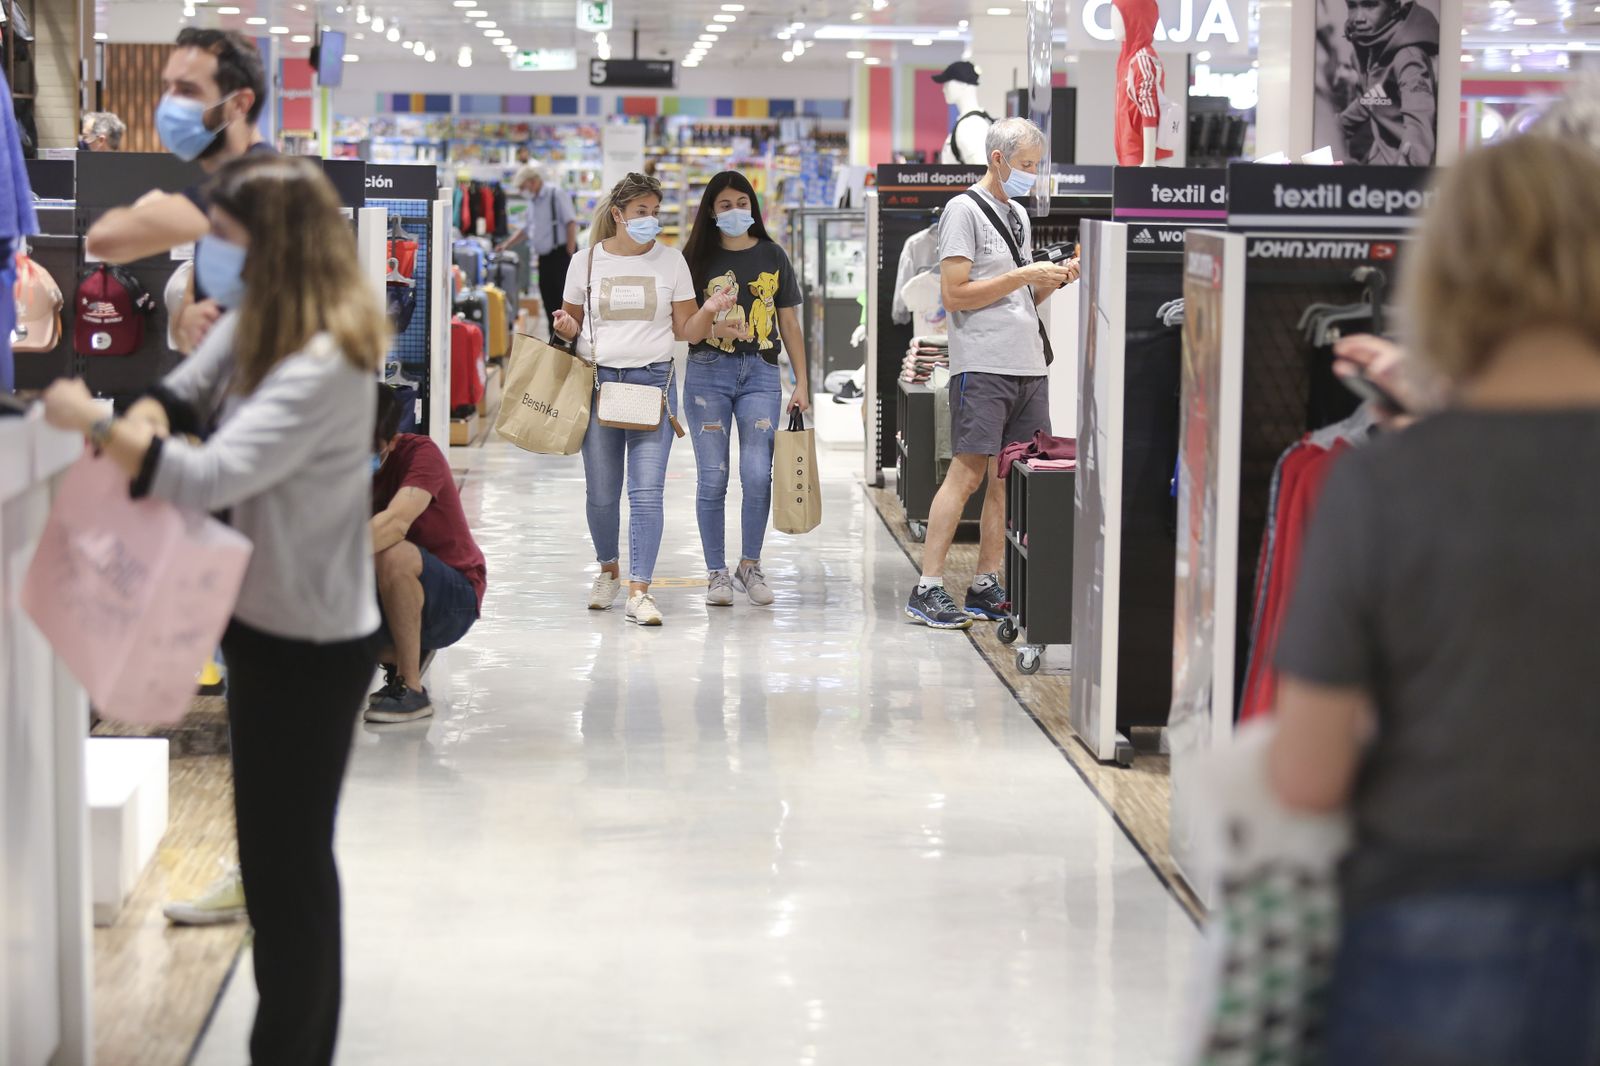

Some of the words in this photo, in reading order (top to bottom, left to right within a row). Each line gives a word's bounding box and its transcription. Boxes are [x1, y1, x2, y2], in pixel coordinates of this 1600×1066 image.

[592, 61, 607, 83] 5
[1360, 97, 1392, 105] adidas
[897, 172, 928, 183] textil
[1151, 183, 1205, 203] textil
[1210, 185, 1228, 203] d
[1273, 183, 1342, 208] textil
[1158, 230, 1186, 243] WO
[1247, 240, 1304, 258] JOHN
[1304, 241, 1370, 259] SMITH
[522, 392, 559, 418] Bershka
